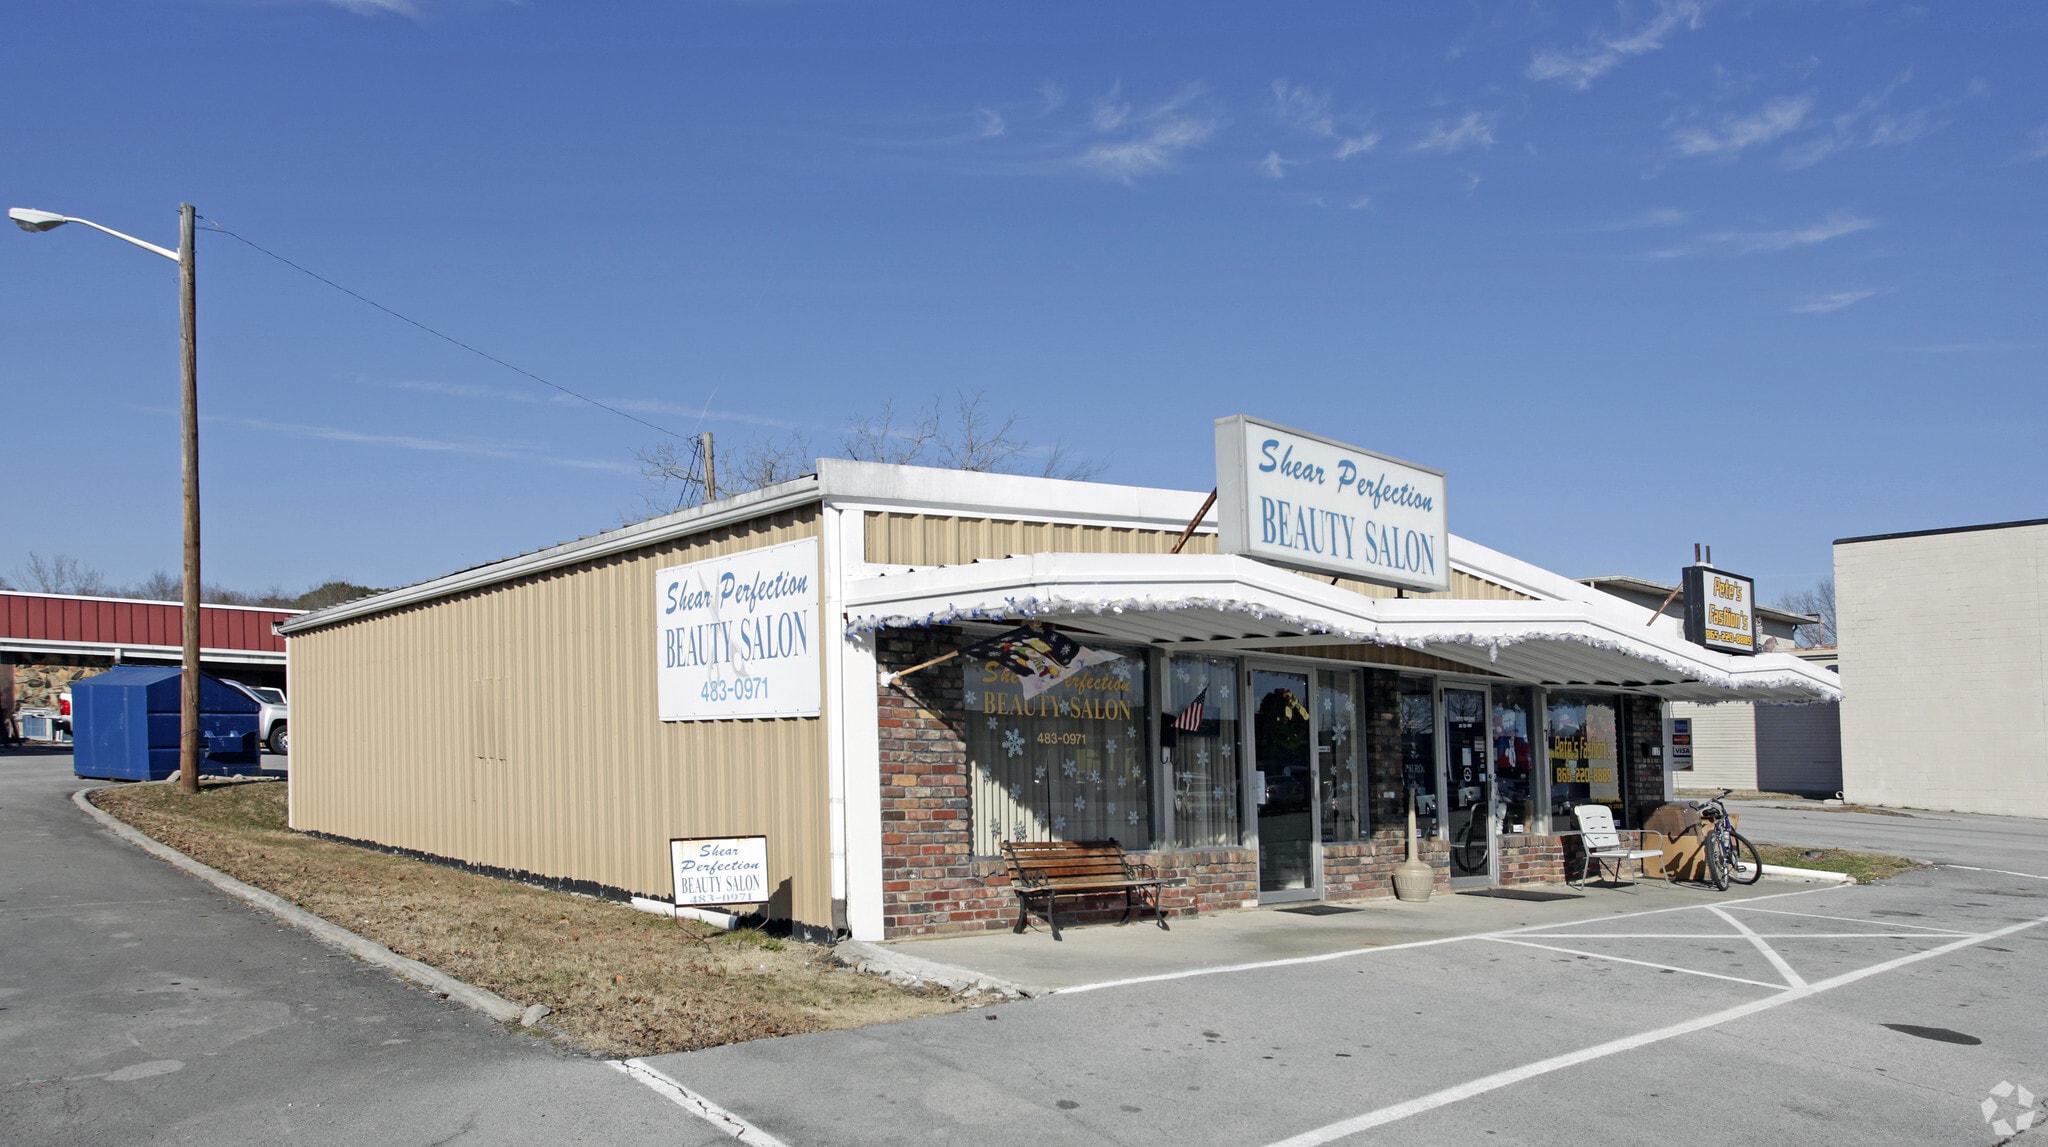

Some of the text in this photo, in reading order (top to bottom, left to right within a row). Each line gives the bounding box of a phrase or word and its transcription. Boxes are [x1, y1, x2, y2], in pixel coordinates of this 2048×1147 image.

[1259, 439, 1433, 512] Shear Perfection
[1260, 495, 1435, 576] BEAUTY SALON
[665, 570, 808, 614] Shear Perfection
[1713, 576, 1742, 602] Pete's
[1708, 603, 1748, 630] Fashion's
[666, 610, 808, 668] BEAUTY SALON
[1705, 629, 1752, 646] 865-220-8889
[701, 676, 769, 702] 483-0971
[982, 660, 1022, 684] She
[1064, 671, 1131, 696] erfection
[983, 691, 1131, 721] BEAUTY SALON
[1037, 732, 1087, 745] 483-0971
[1554, 735, 1579, 759] Pete's
[1556, 767, 1613, 783] 865-220-8889
[699, 844, 739, 857] Shear
[681, 860, 760, 875] Perfection
[681, 874, 760, 894] BEAUTY SALON
[690, 893, 752, 904] 483-0971
